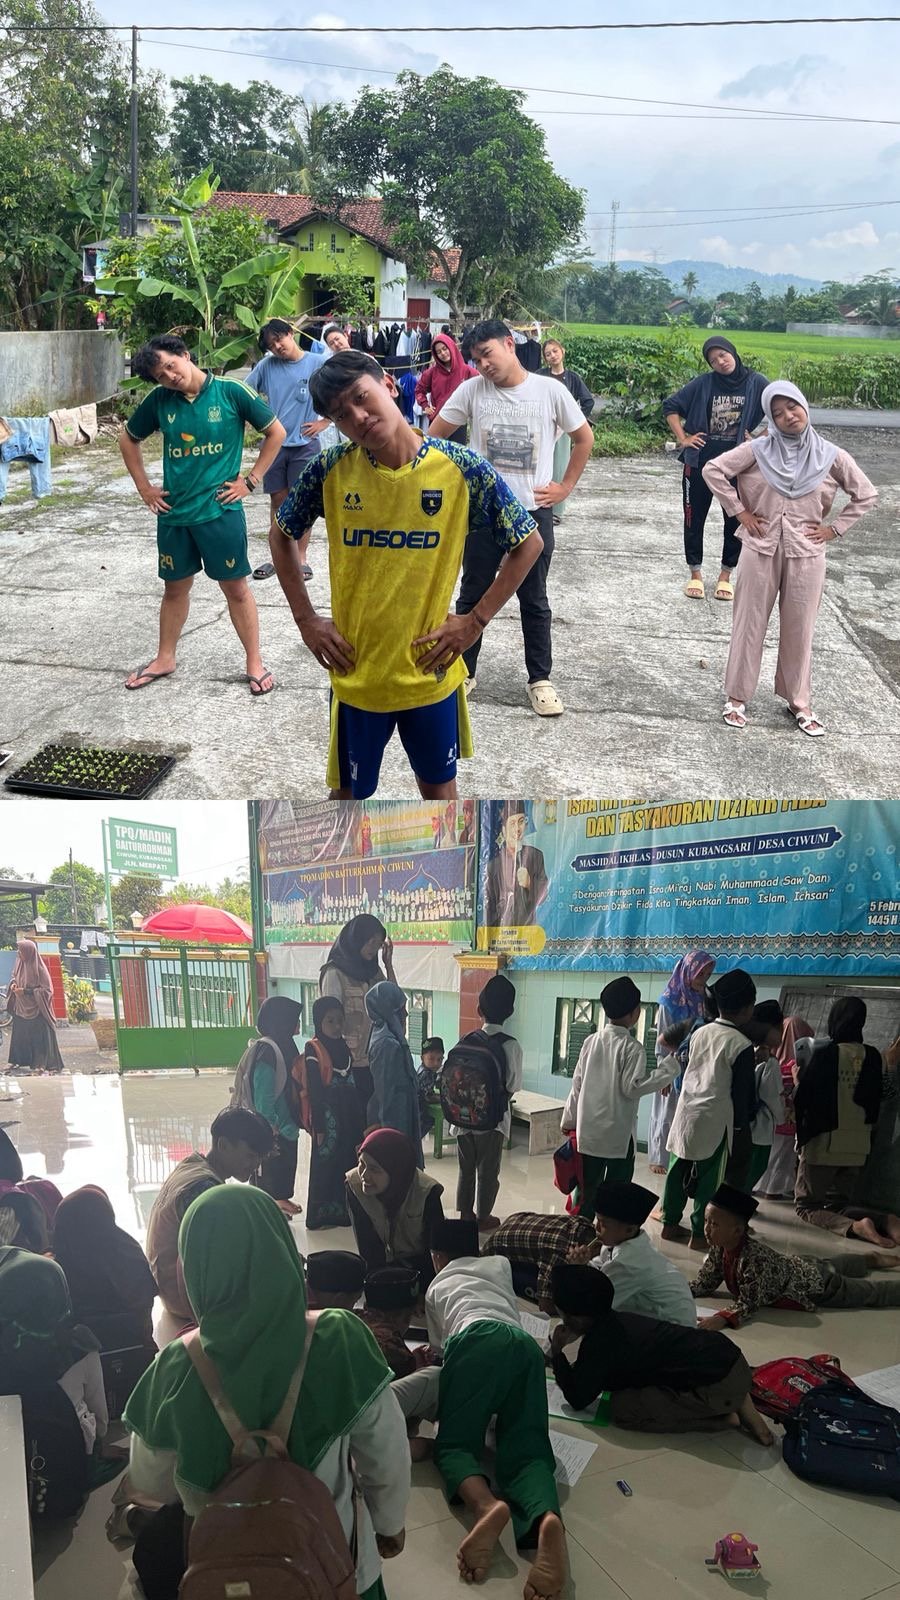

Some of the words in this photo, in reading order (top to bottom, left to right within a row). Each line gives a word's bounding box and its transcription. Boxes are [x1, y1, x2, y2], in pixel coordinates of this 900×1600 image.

[343, 528, 440, 549] UNSOED
[586, 814, 617, 838] DAN
[618, 800, 715, 834] TASYAKURAN
[656, 848, 685, 860] DUSUN
[688, 841, 751, 857] KUBANGSARI
[758, 837, 785, 850] DESA
[787, 833, 829, 847] CIWUNI
[387, 860, 414, 873] CIWUNI
[649, 885, 664, 894] Isra
[695, 881, 717, 891] Nabi
[783, 875, 804, 887] Saw
[807, 873, 827, 884] Dan
[656, 899, 671, 908] Kita
[675, 897, 722, 909] Tingkatkan
[870, 901, 877, 911] 5
[868, 914, 890, 926] 1445
[890, 914, 898, 926] H
